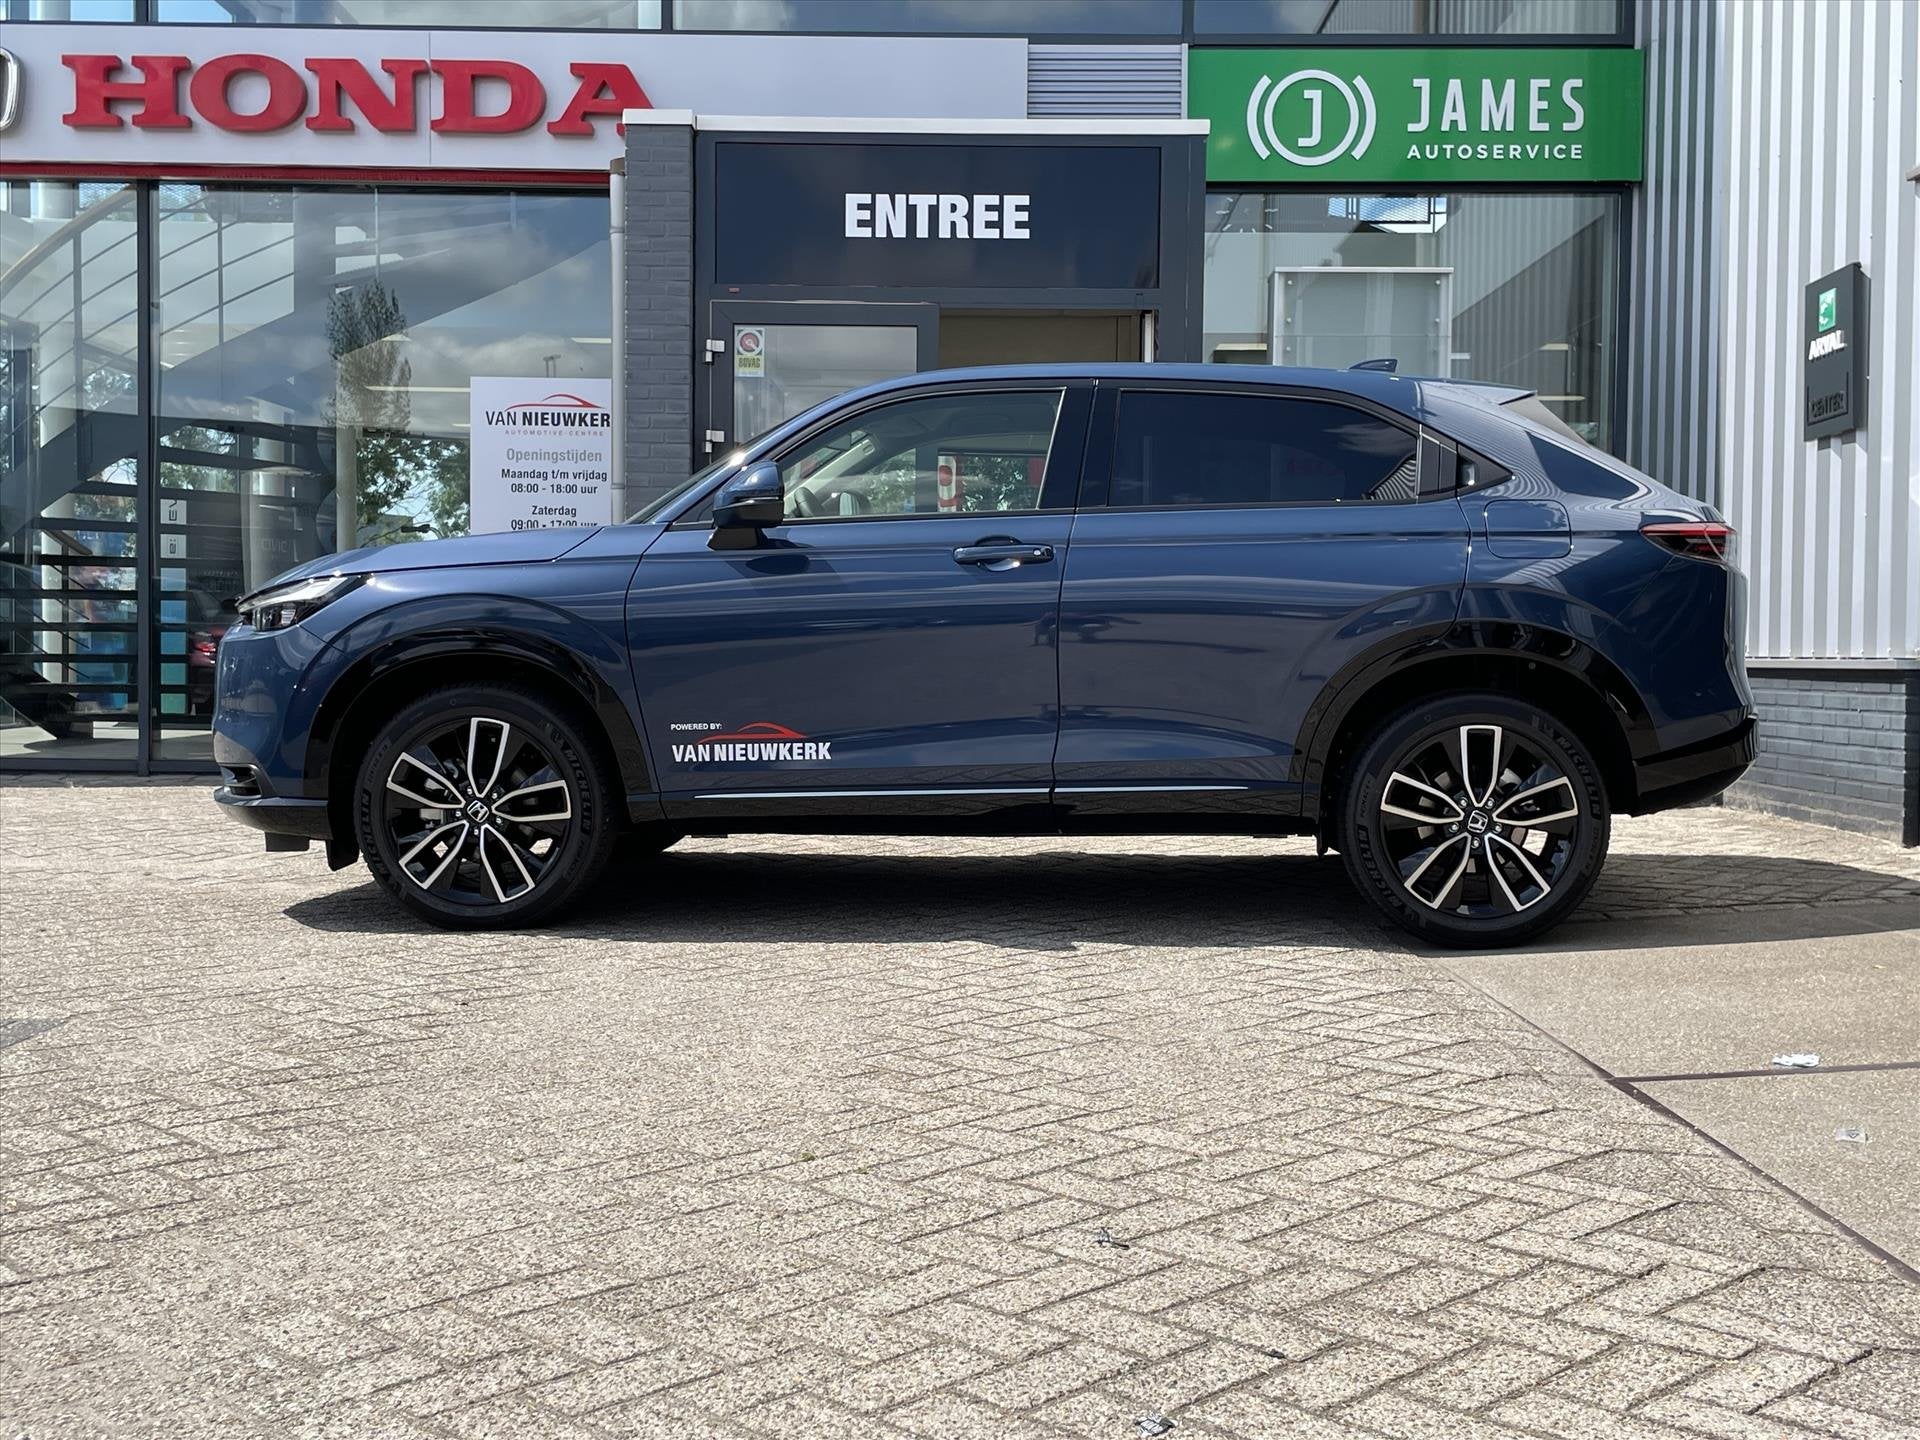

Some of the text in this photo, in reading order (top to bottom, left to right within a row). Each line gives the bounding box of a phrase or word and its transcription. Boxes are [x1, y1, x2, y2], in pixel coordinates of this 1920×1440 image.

[61, 53, 655, 137] HONDA
[1407, 78, 1585, 132] JAMES
[1407, 144, 1583, 160] AUTOSERVICE
[845, 193, 1031, 240] ENTREE
[1808, 329, 1846, 361] ARVAL
[485, 410, 611, 428] VAN NIEUWKER
[504, 429, 563, 437] AUTOMOTIVE
[506, 447, 603, 464] Openingstijden
[501, 468, 608, 482] Maandag t/m vrijdag
[510, 483, 539, 494] 08:00
[550, 483, 578, 494] 18:00
[580, 485, 598, 494] uur
[531, 505, 577, 517] Zaterdag
[510, 519, 539, 530] 09:00
[670, 722, 723, 731] POWERED BY:
[672, 742, 832, 762] VAN NIEUWKERK
[1555, 735, 1603, 820] MICHELIN
